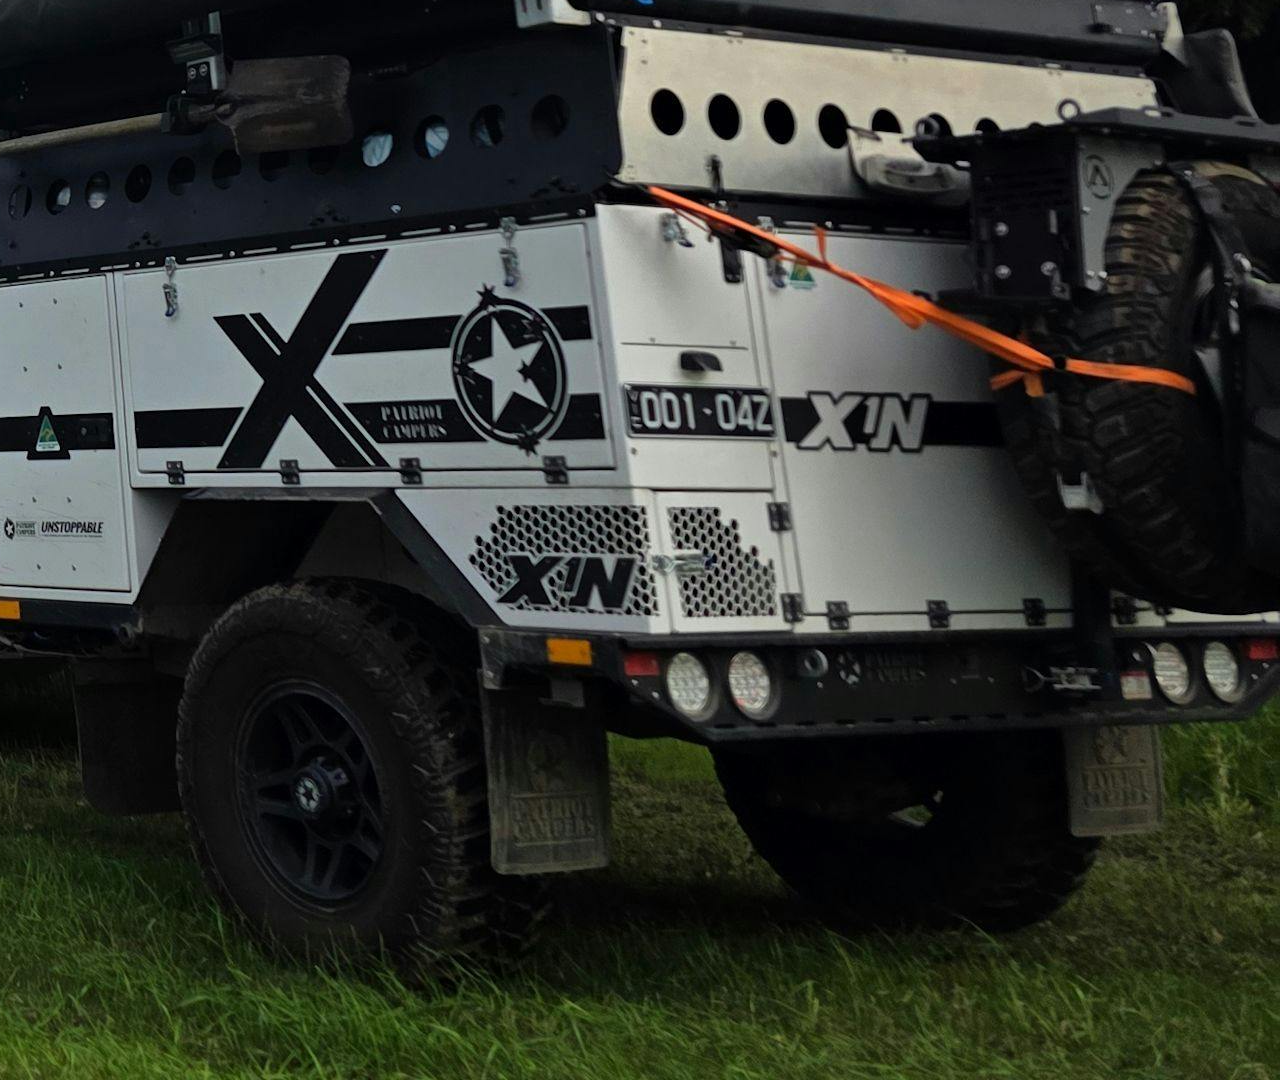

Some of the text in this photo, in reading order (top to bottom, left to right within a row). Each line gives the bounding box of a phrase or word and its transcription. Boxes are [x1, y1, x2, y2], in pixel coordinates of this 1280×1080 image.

[380, 404, 443, 422] PATRIOT
[382, 423, 448, 439] CAMPERS
[41, 521, 104, 534] UNSTOPPABLE
